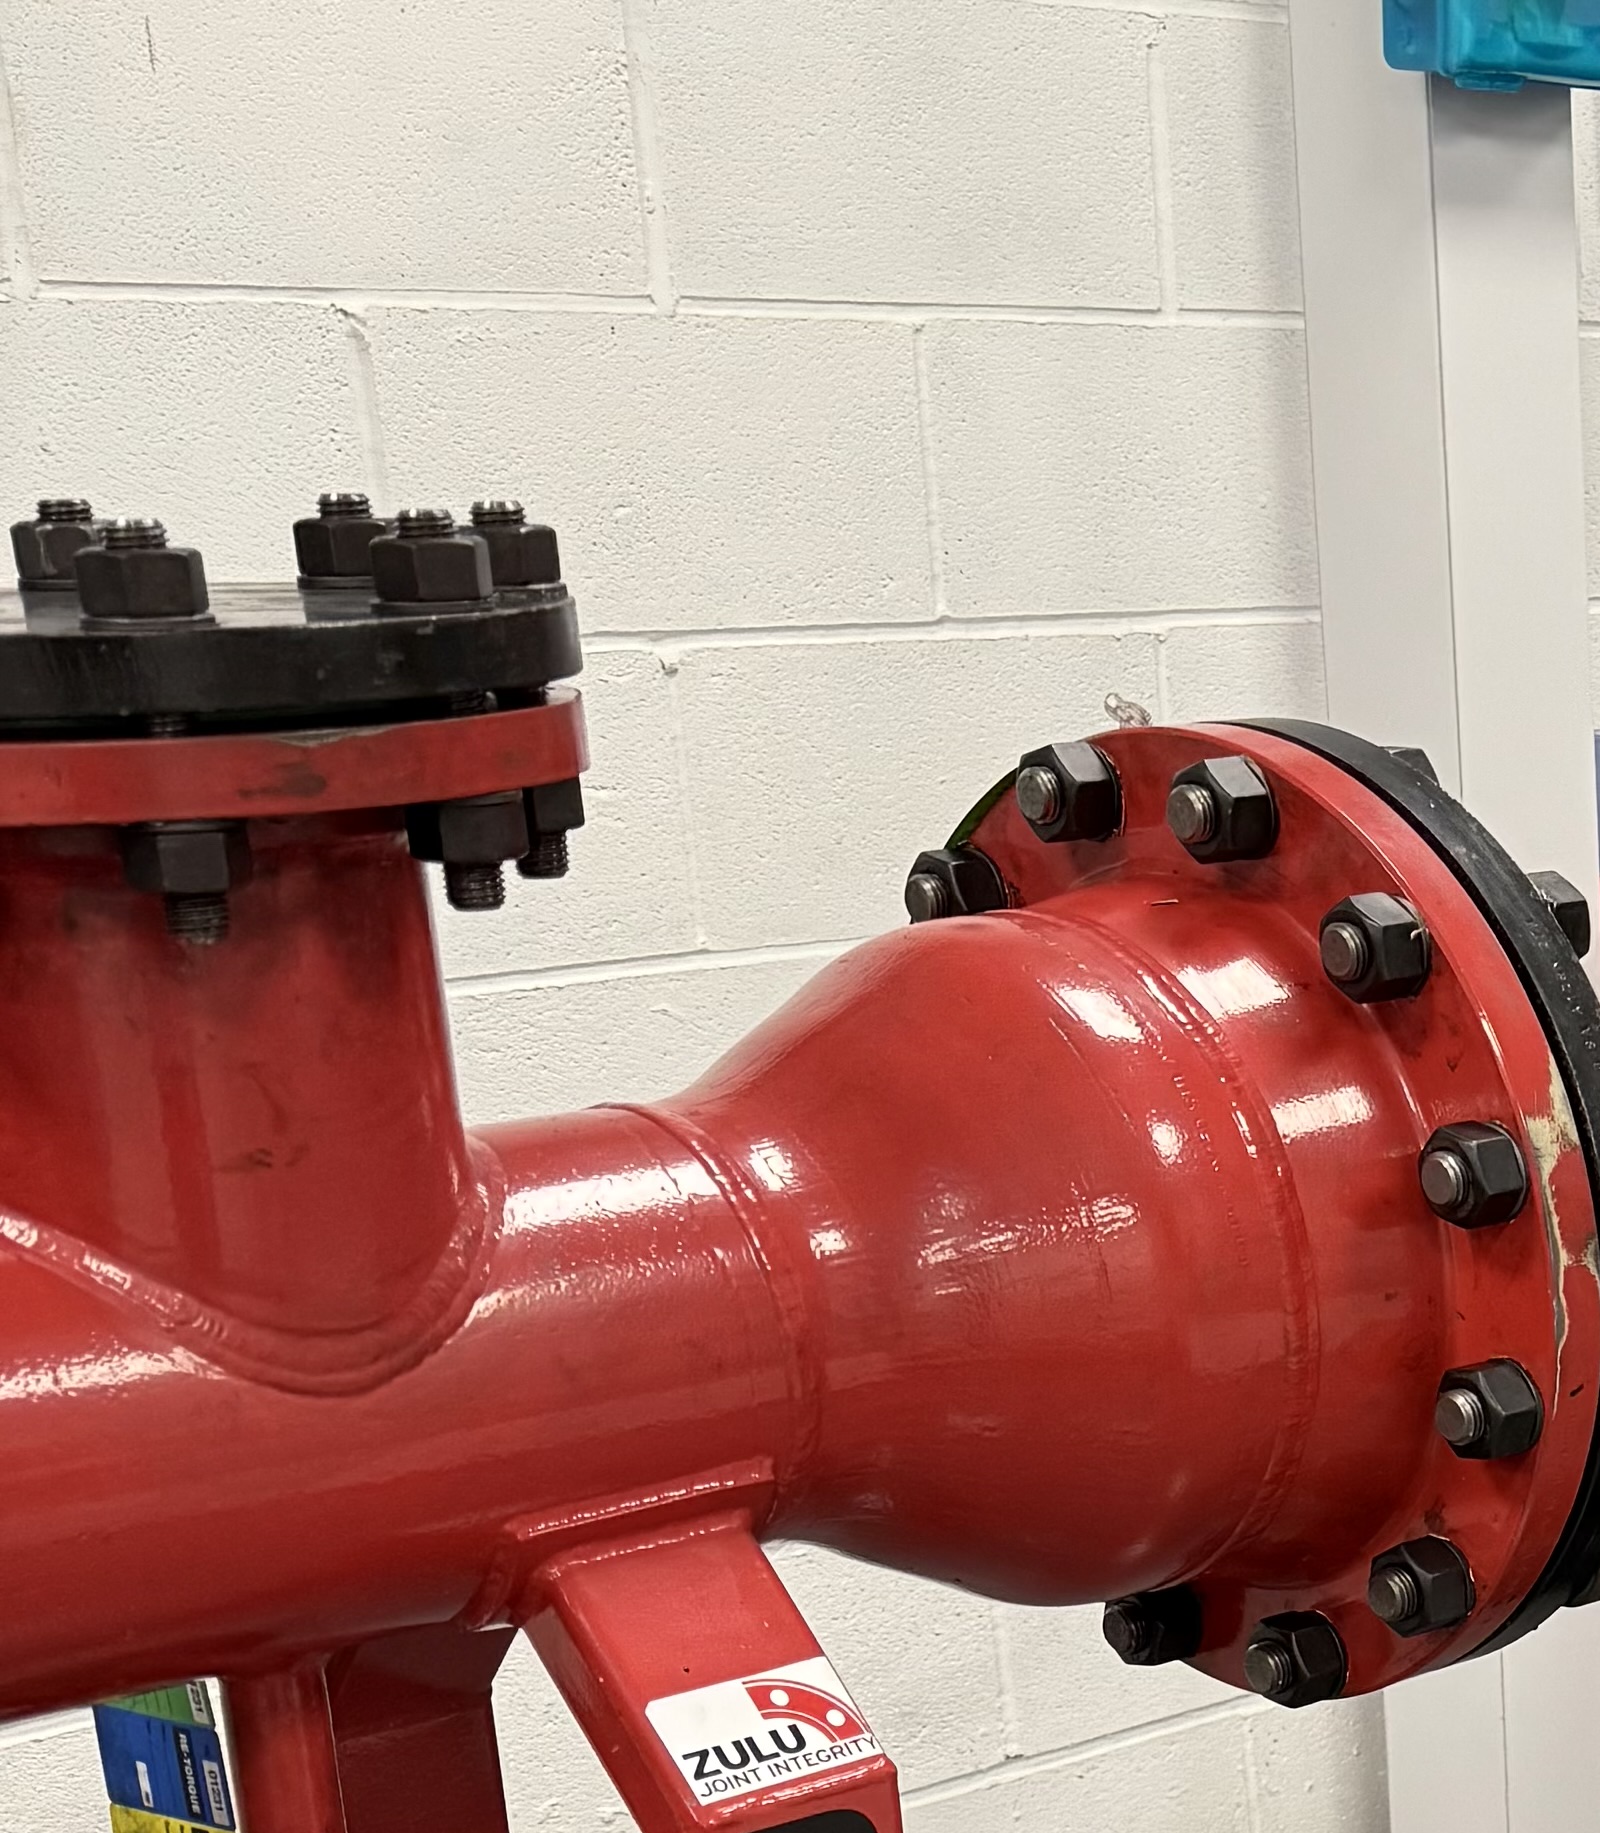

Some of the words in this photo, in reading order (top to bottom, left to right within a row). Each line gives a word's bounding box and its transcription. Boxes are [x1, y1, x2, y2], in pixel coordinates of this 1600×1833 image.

[178, 1733, 200, 1815] RE-TORQUE
[682, 1724, 807, 1781] ZULU
[701, 1766, 761, 1797] JOINT
[769, 1735, 878, 1777] INTEGRITY
